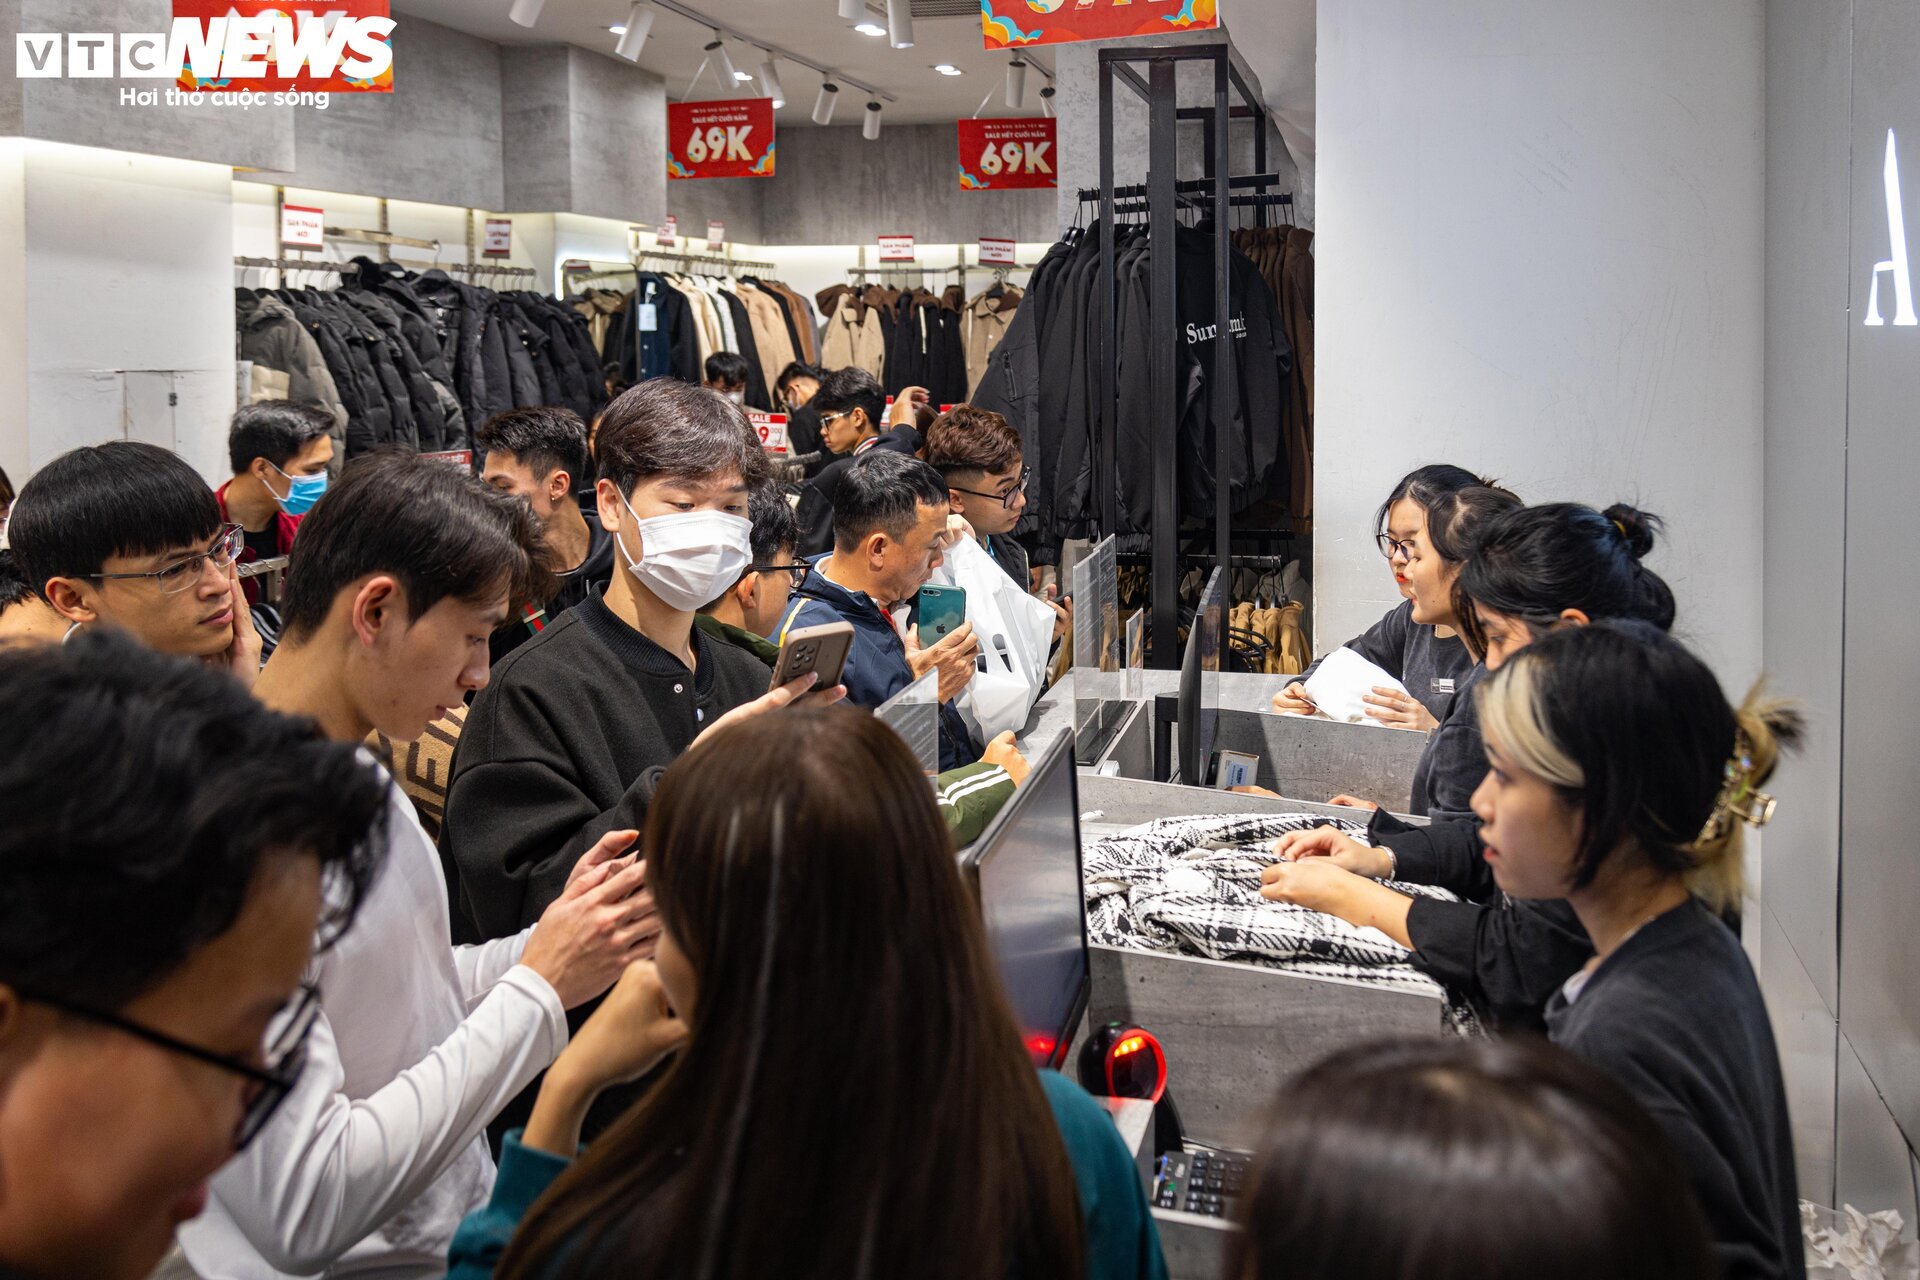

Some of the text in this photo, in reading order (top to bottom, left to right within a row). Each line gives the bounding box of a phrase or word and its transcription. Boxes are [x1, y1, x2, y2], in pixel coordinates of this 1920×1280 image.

[687, 125, 753, 163] 69K
[984, 131, 1001, 139] SALE
[980, 141, 1053, 175] 69K
[748, 413, 771, 422] SALE
